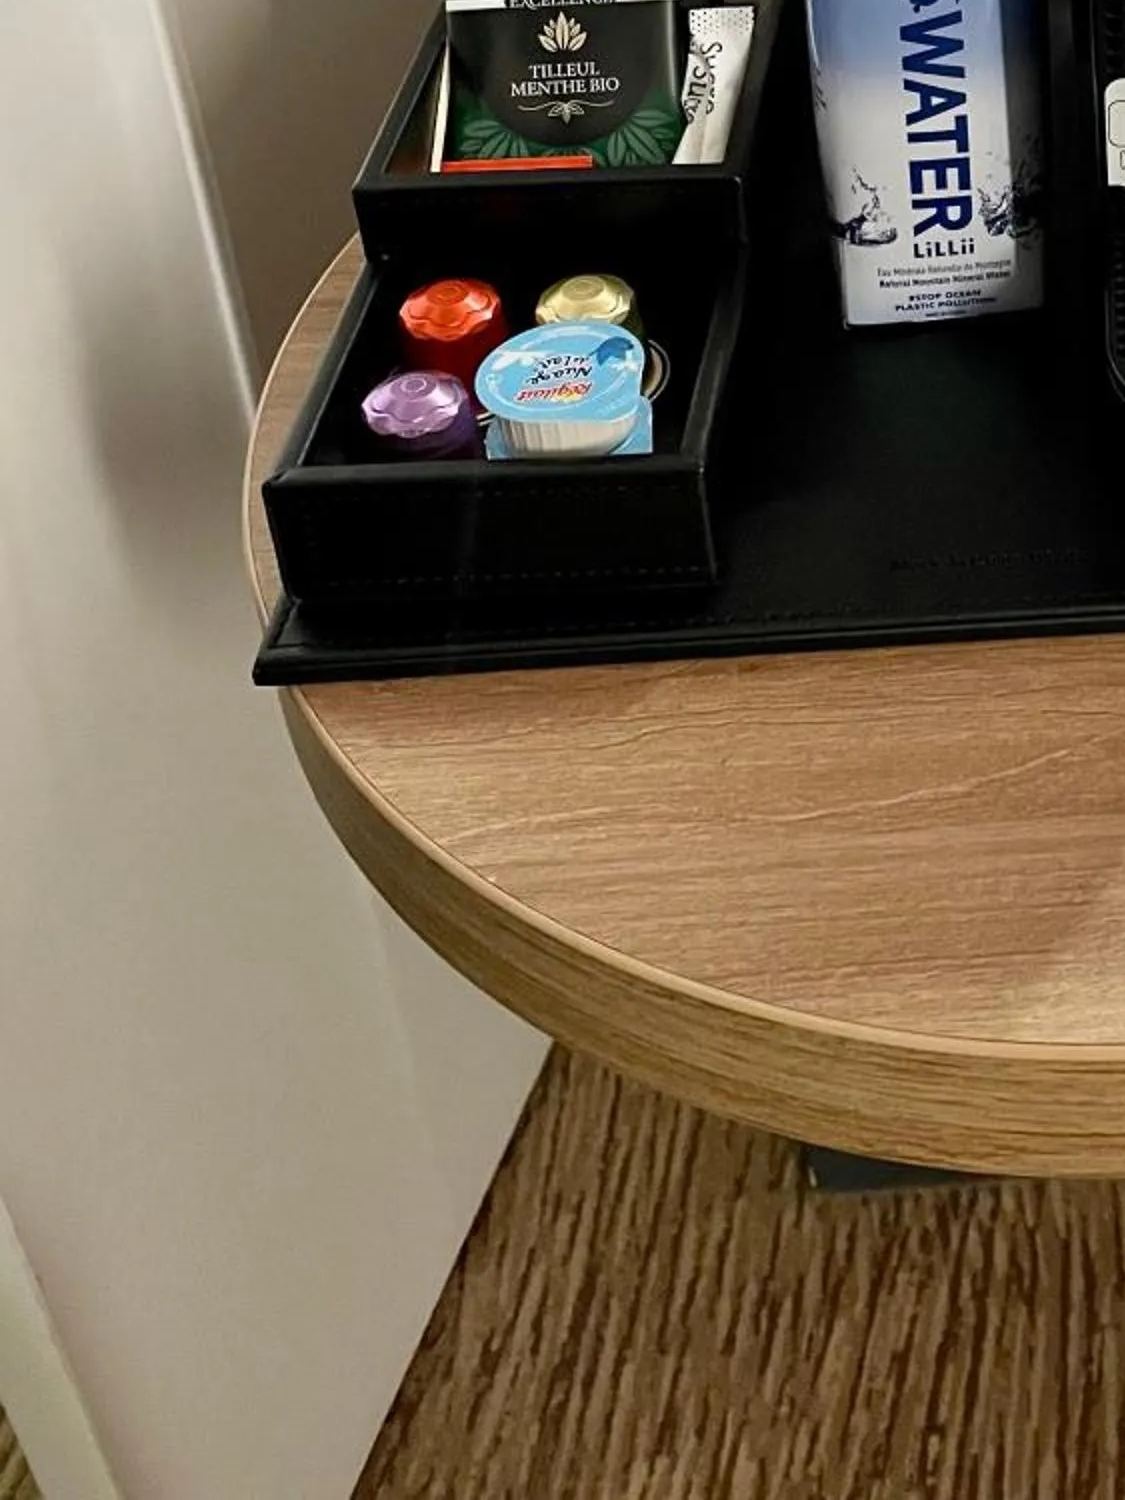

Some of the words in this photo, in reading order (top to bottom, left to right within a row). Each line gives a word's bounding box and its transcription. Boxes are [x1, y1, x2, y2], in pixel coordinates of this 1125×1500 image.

[528, 61, 600, 79] TILLEUL
[510, 78, 586, 97] MENTHE
[589, 76, 620, 93] BIO
[899, 10, 974, 238] WATER
[912, 238, 976, 260] LiLLii
[945, 289, 981, 300] OCEAN
[895, 301, 936, 312] PLASTIC
